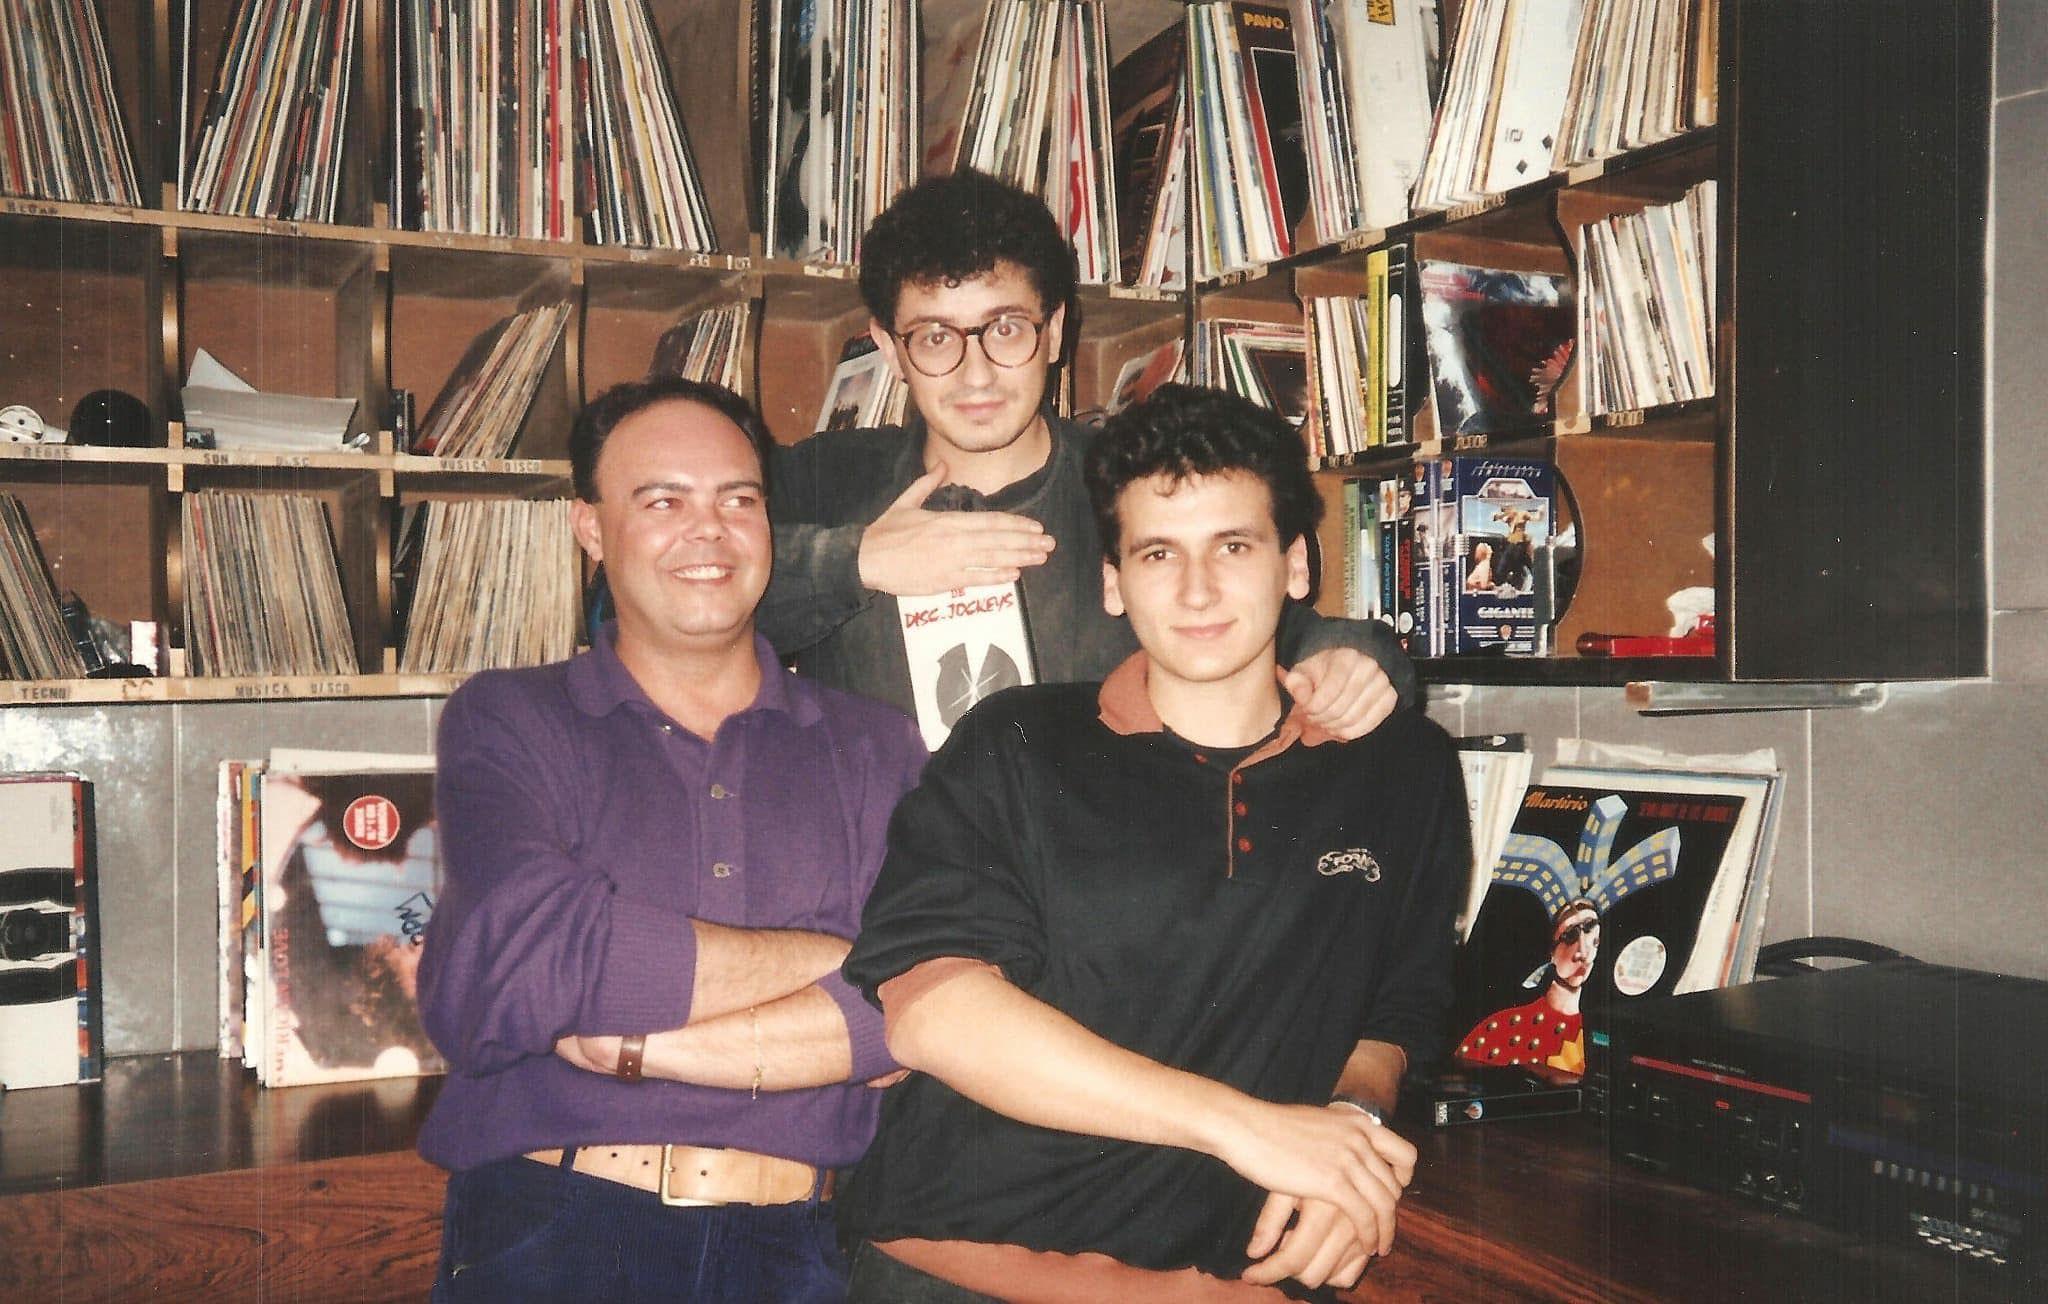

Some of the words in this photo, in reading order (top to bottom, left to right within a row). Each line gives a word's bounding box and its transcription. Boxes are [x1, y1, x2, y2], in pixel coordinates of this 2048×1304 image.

[503, 461, 540, 471] DISCO
[235, 684, 290, 697] MUSICA
[310, 682, 350, 695] DISCO
[1524, 791, 1588, 811] Martirio
[272, 927, 290, 978] LOVE
